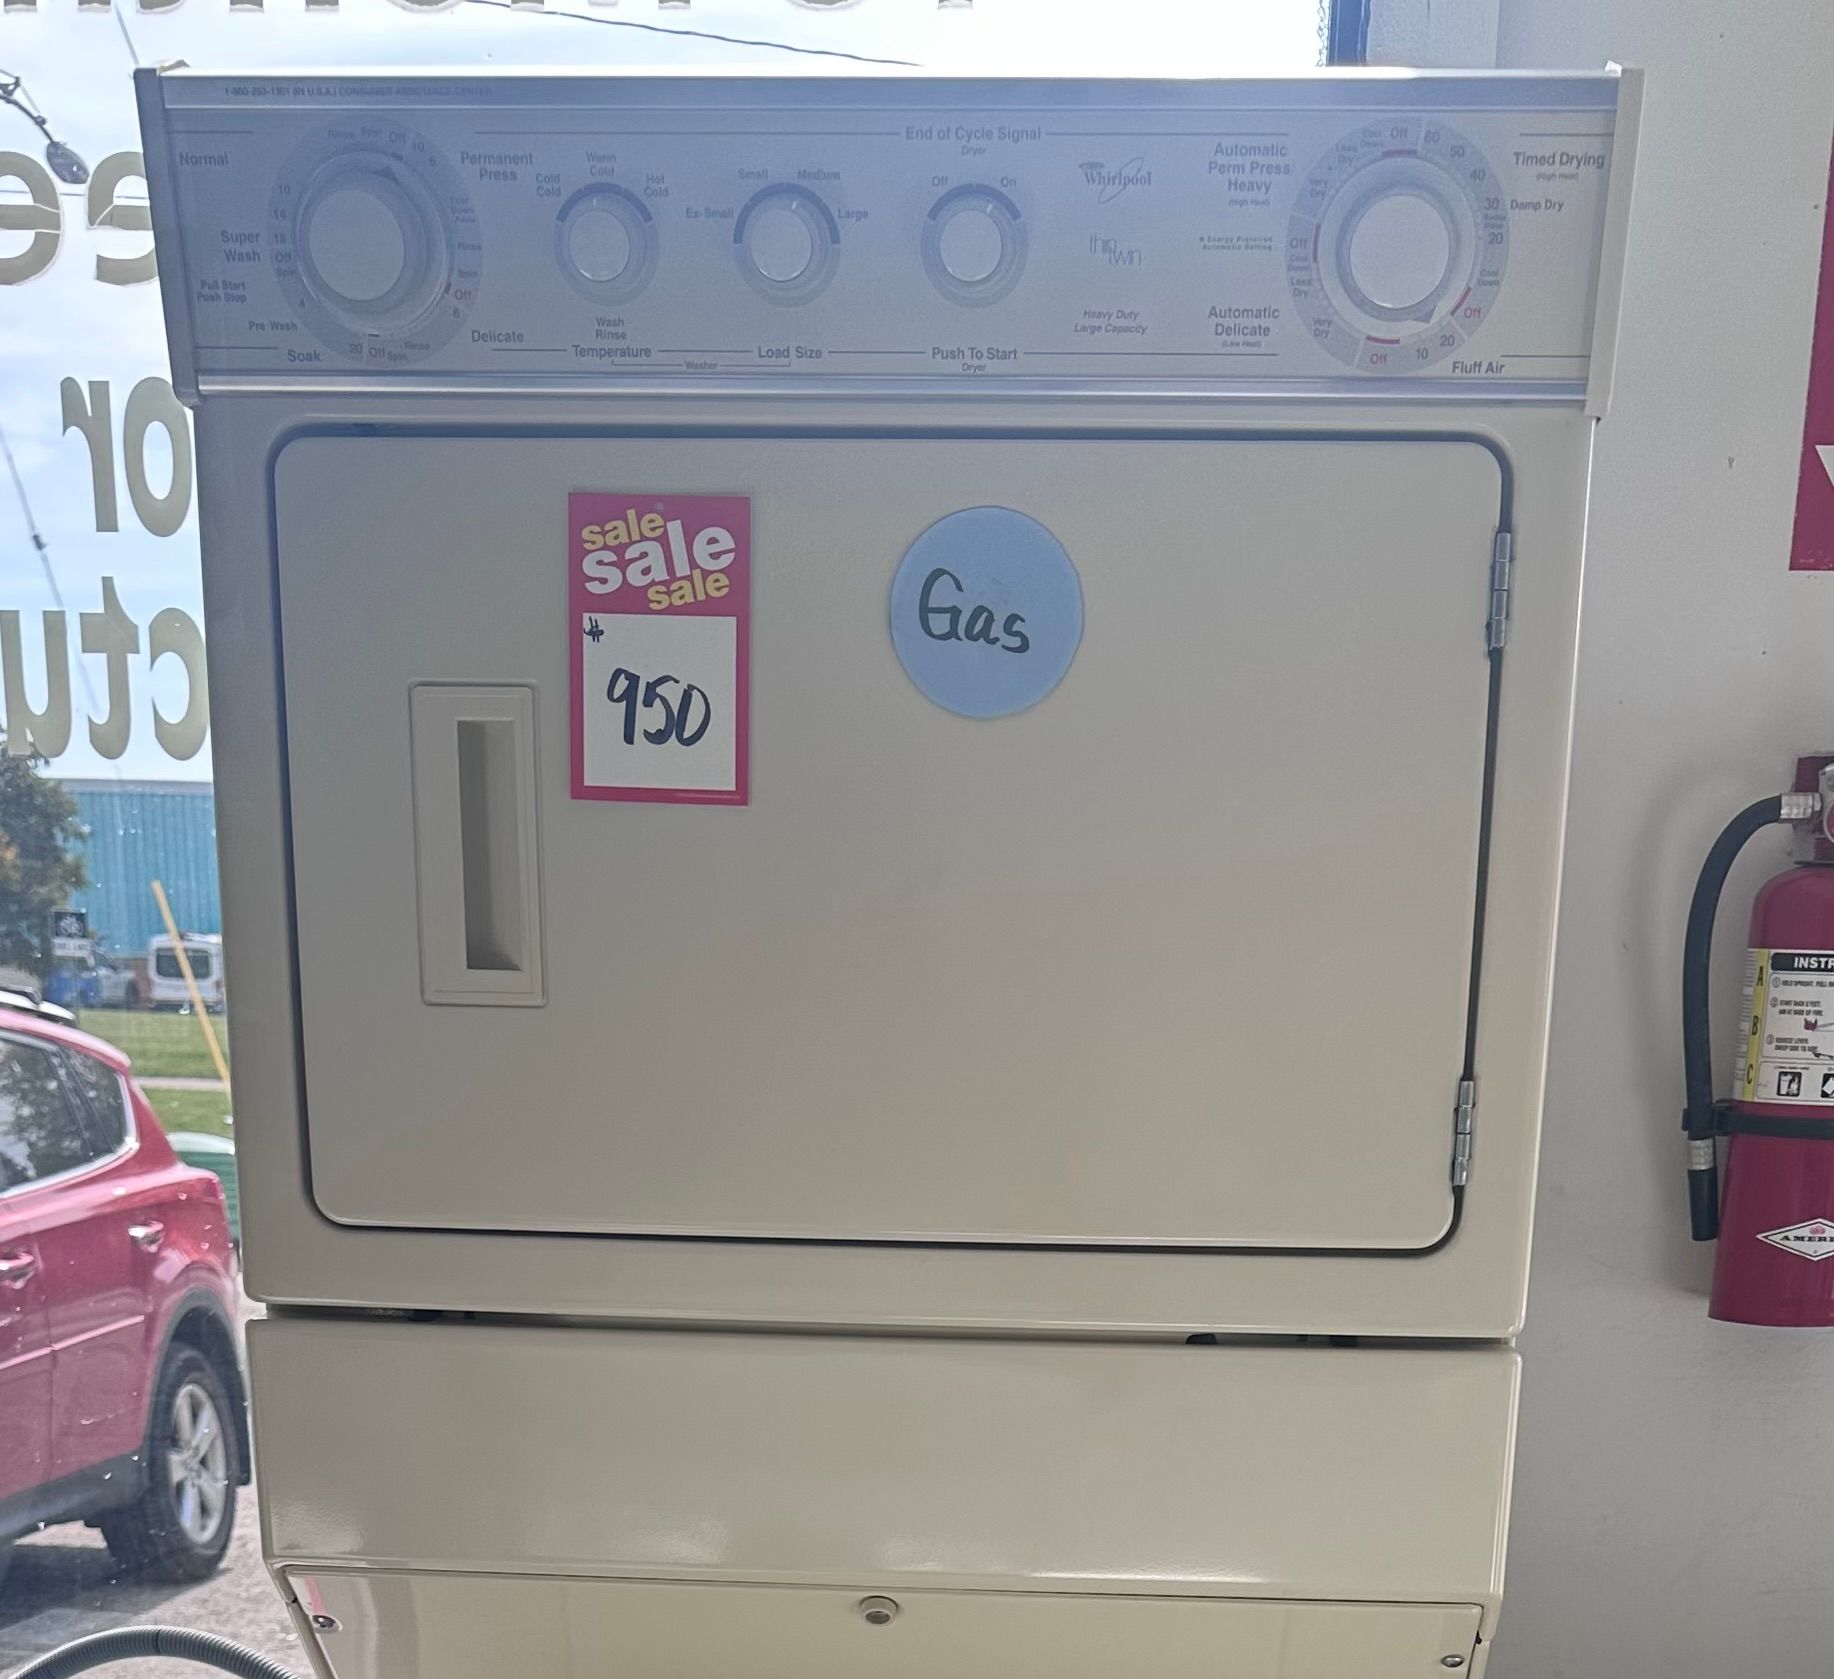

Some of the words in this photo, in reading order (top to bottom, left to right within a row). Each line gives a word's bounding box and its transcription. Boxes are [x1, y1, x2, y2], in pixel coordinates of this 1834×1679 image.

[389, 131, 406, 144] Off
[904, 126, 933, 141] End
[937, 126, 951, 141] of
[954, 126, 994, 144] Cycle
[997, 126, 1042, 144] Signal
[1389, 126, 1409, 140] Off
[412, 141, 426, 153] 10
[961, 145, 987, 157] Dryer
[1213, 141, 1289, 158] Automatic
[1449, 144, 1465, 158] 50
[179, 151, 229, 167] Normal
[460, 152, 534, 166] Permanent
[585, 151, 617, 164] Warm
[1513, 151, 1556, 167] Timed
[1559, 151, 1605, 169] Drying
[479, 168, 518, 182] Press
[589, 164, 616, 177] Cold
[737, 167, 769, 181] Small
[797, 168, 841, 181] Medium
[1208, 160, 1246, 176] Perm
[1249, 160, 1290, 176] Press
[1470, 168, 1486, 182] 40
[535, 172, 561, 185] Cold
[645, 172, 666, 185] Hot
[931, 175, 949, 187] Off
[1000, 176, 1017, 188] On
[1082, 168, 1153, 190] Whirlpool
[279, 183, 292, 196] 10
[536, 185, 562, 198] Cold
[643, 185, 670, 198] Cold
[1227, 178, 1272, 195] Heavy
[1484, 196, 1500, 211] 30
[1509, 199, 1542, 212] Damp
[1544, 199, 1565, 212] Dry
[273, 208, 288, 221] 14
[838, 207, 869, 222] Large
[220, 229, 261, 246] Super
[1290, 236, 1308, 250] Off
[1488, 232, 1504, 245] 20
[224, 249, 262, 264] Wash
[275, 250, 293, 264] Off
[200, 279, 219, 291] Pull
[222, 279, 246, 291] Start
[197, 291, 221, 303] Push
[222, 291, 247, 304] Stop
[454, 287, 472, 301] Off
[1082, 308, 1114, 323] Heavy
[1115, 308, 1140, 323] Duty
[1207, 305, 1281, 320] Automatic
[1463, 306, 1481, 319] Off
[595, 316, 625, 329] Wash
[1074, 322, 1103, 336] Large
[1104, 322, 1149, 336] Capacity
[1214, 322, 1271, 337] Delicate
[471, 329, 525, 344] Delicate
[595, 328, 628, 341] Rinse
[1440, 334, 1456, 348] 20
[287, 348, 323, 363] Soak
[348, 343, 363, 356] 20
[369, 346, 386, 360] Off
[571, 345, 653, 362] Temperature
[756, 345, 791, 360] Load
[794, 345, 823, 360] Size
[930, 346, 963, 361] Push
[966, 346, 984, 361] To
[986, 346, 1019, 361] Start
[1416, 347, 1429, 361] 10
[683, 358, 719, 371] Washer
[1369, 351, 1388, 365] Off
[961, 361, 987, 374] Dryer
[1451, 360, 1482, 375] Fluff
[1484, 360, 1506, 375] Air
[581, 508, 666, 551] sale
[581, 518, 737, 595] sale
[647, 567, 731, 611] sale
[918, 567, 1031, 654] Gas
[606, 667, 712, 747] 950
[1756, 965, 1764, 987] A
[1751, 1015, 1760, 1036] B
[1746, 1064, 1754, 1085] C
